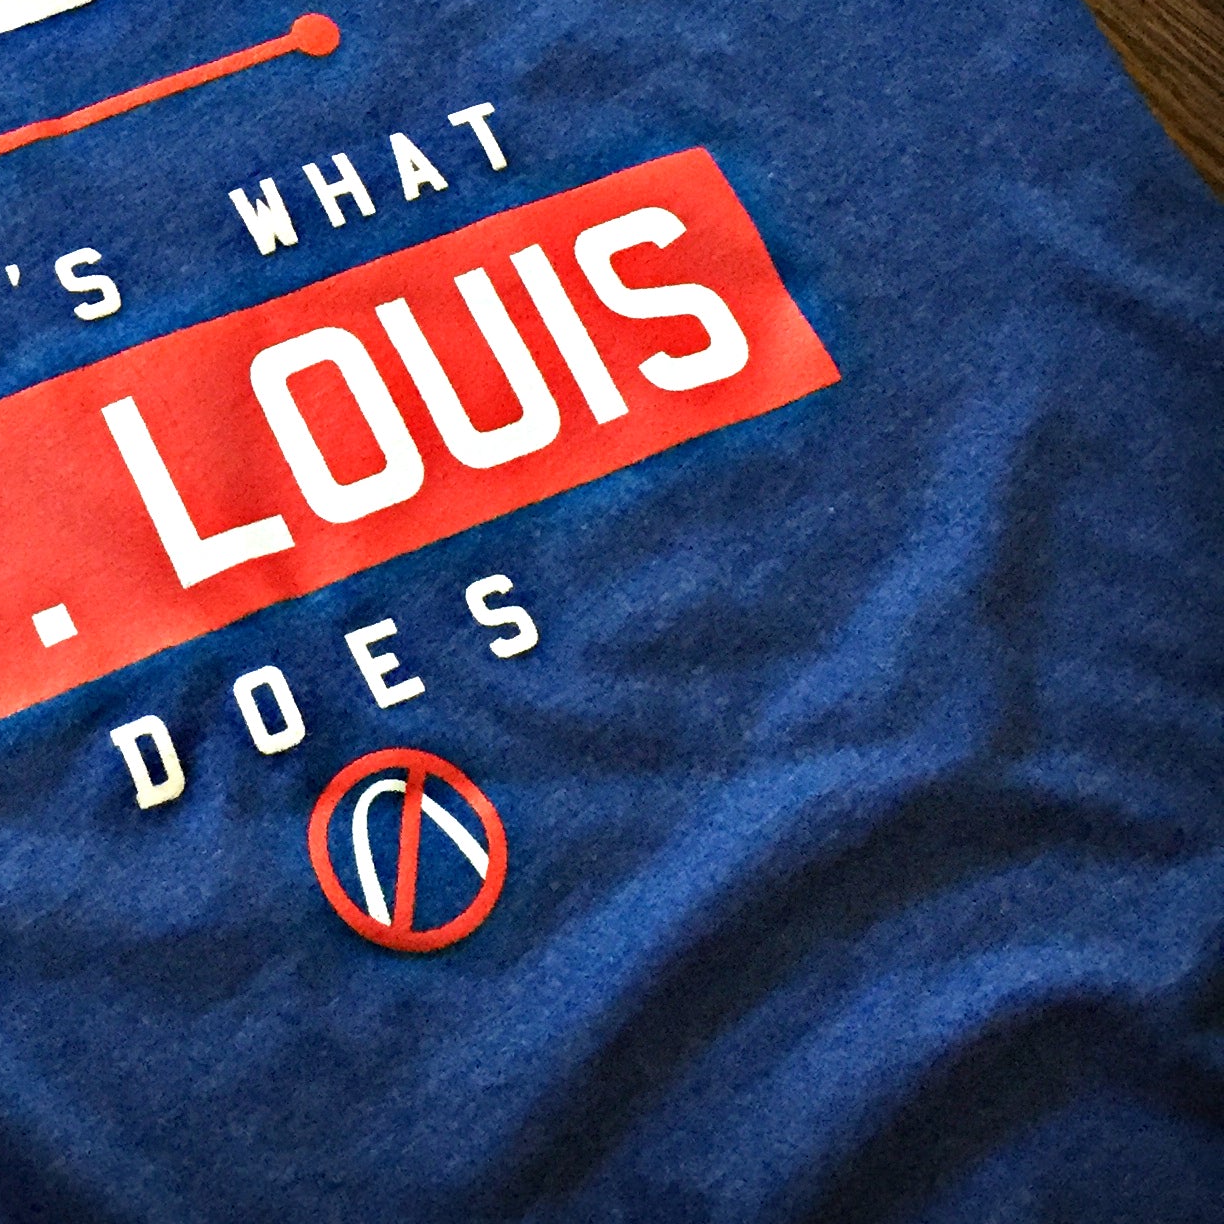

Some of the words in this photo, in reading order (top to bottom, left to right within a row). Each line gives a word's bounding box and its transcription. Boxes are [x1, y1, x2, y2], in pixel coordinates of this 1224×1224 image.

[229, 102, 507, 256] WHAT
[101, 207, 749, 589] LOUIS
[110, 574, 539, 810] DOES
